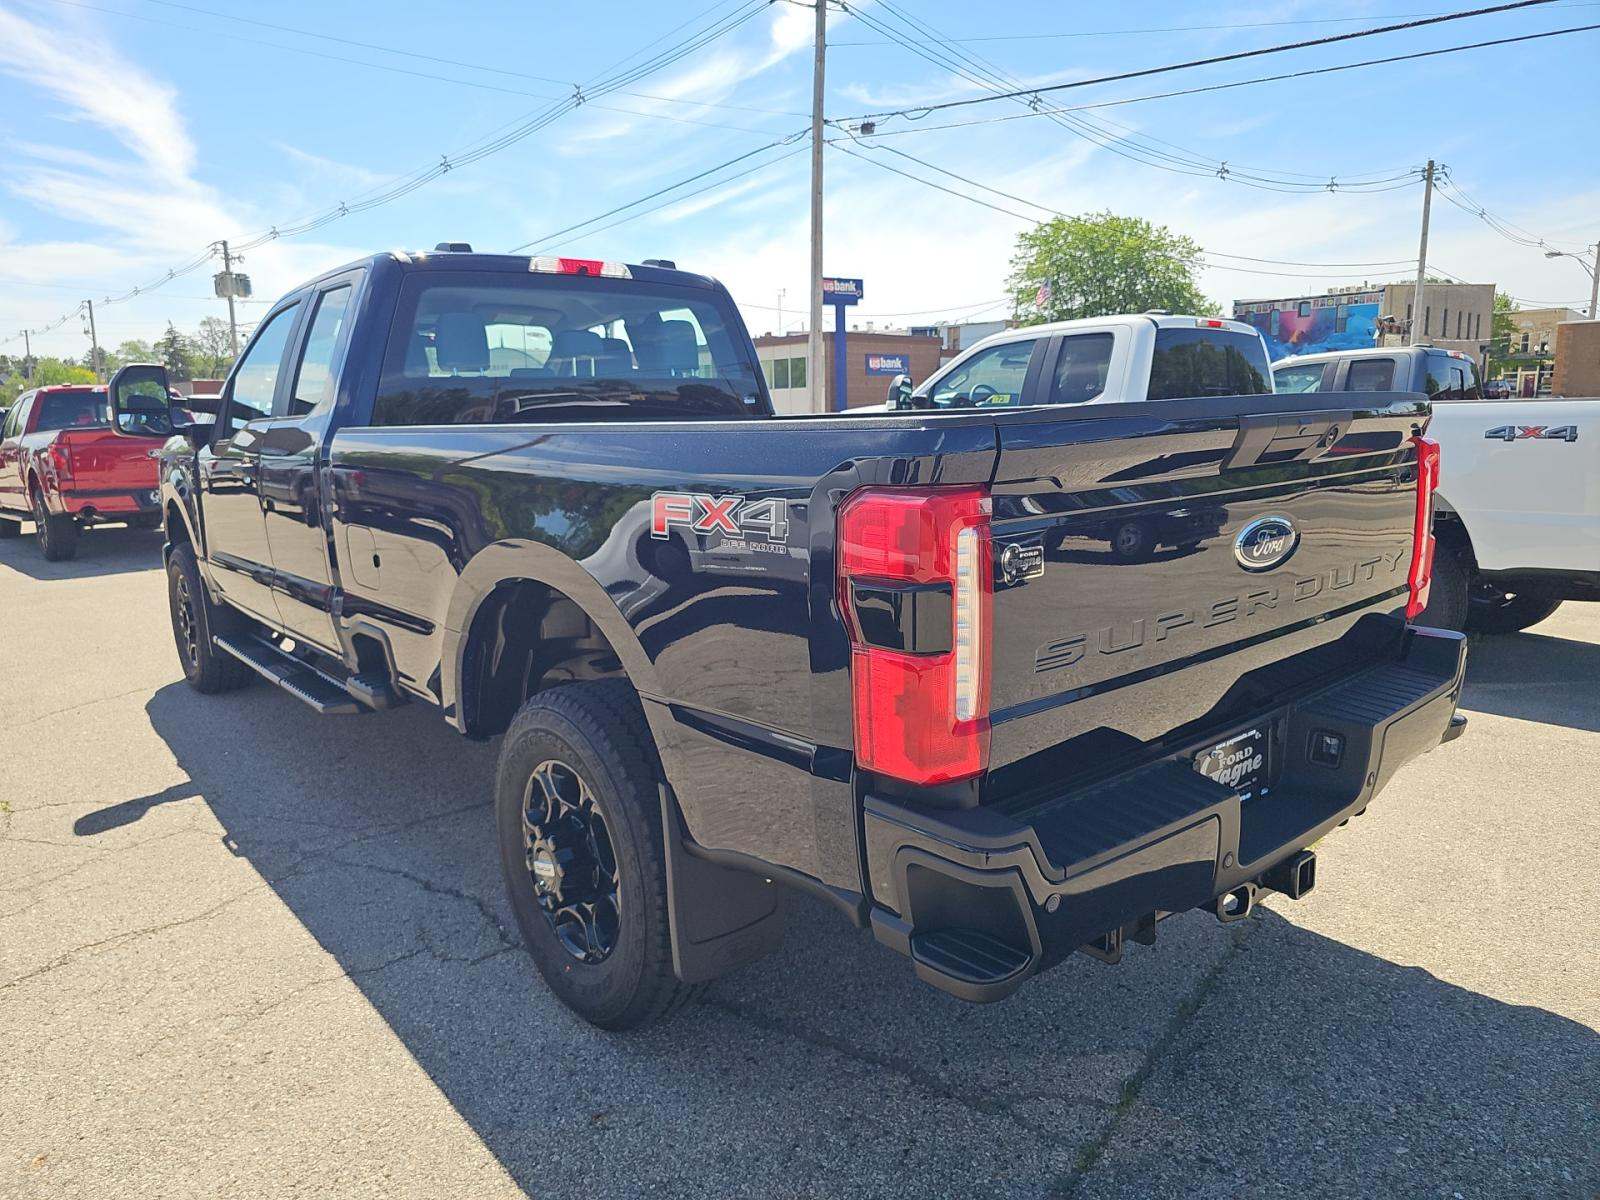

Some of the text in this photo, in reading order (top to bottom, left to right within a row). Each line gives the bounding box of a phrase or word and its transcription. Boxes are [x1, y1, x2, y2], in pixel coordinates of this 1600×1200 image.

[650, 490, 789, 543] FX4
[720, 539, 787, 555] OFF ROAD
[1020, 550, 1039, 559] FORD
[1253, 530, 1285, 557] Ford
[1033, 549, 1404, 674] SUPER DUTY
[1219, 747, 1253, 768] FORD
